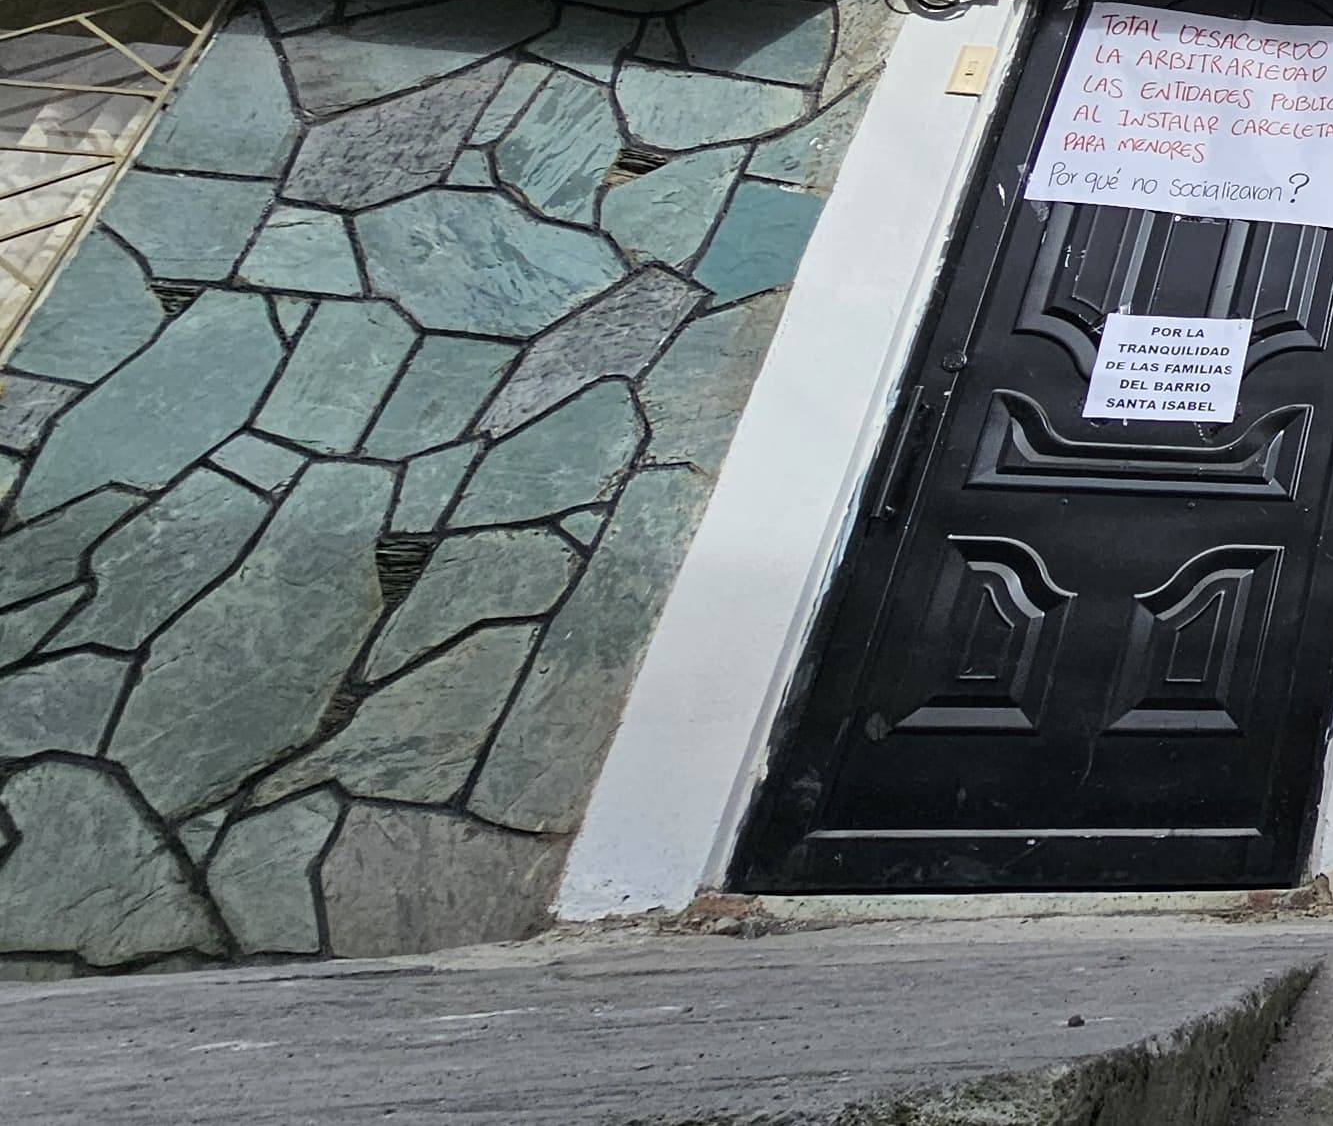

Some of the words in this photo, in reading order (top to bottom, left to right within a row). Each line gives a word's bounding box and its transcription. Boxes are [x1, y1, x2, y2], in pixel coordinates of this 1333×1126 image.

[1101, 13, 1162, 42] TOTAL
[1179, 24, 1328, 62] DESACUERDO
[1095, 45, 1121, 65] LA
[1136, 49, 1328, 82] ARBITRARIEDAD
[1083, 75, 1123, 100] LAS
[1140, 82, 1254, 110] ENTIDADES
[1072, 105, 1101, 122] AL
[1118, 109, 1219, 132] INSTALAR
[1063, 132, 1105, 152] PARA
[1118, 138, 1206, 163] MENORES
[1047, 161, 1076, 188] Por
[1085, 168, 1120, 193] qué
[1131, 177, 1158, 195] no
[1151, 327, 1182, 338] POR
[1187, 329, 1205, 338] LA
[1118, 344, 1230, 356] TRANQUILIDAD
[1105, 362, 1126, 370] DE
[1130, 362, 1159, 372] LAS
[1164, 364, 1232, 375] FAMILIAS
[1120, 379, 1148, 390] DEL
[1154, 382, 1211, 393] BARRIO
[1106, 398, 1156, 409] SANTA
[1162, 401, 1216, 412] ISABEL
